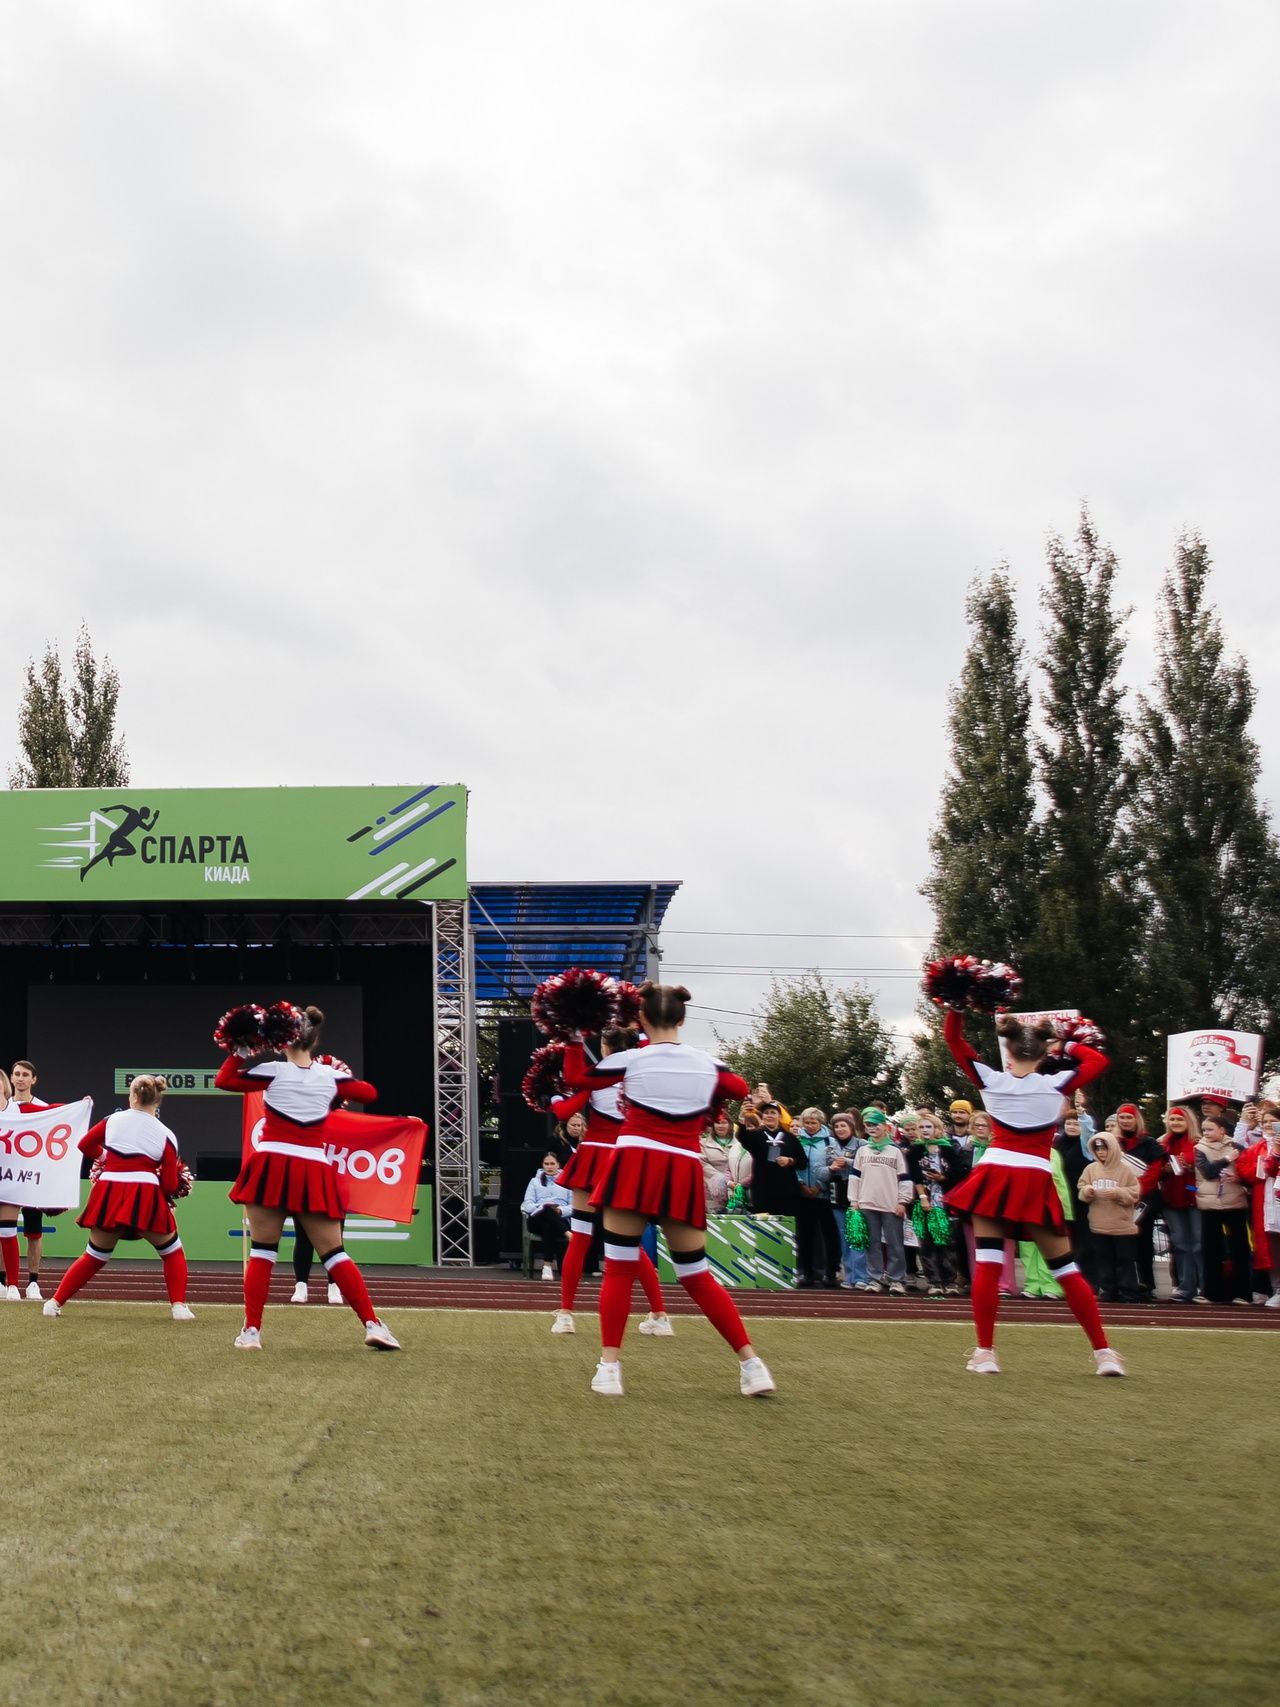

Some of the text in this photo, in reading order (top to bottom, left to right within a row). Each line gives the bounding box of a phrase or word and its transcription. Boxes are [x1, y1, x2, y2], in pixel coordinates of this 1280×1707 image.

[141, 835, 250, 864] СПАРТА
[204, 866, 251, 884] КИАДА
[17, 1169, 41, 1185] №1
